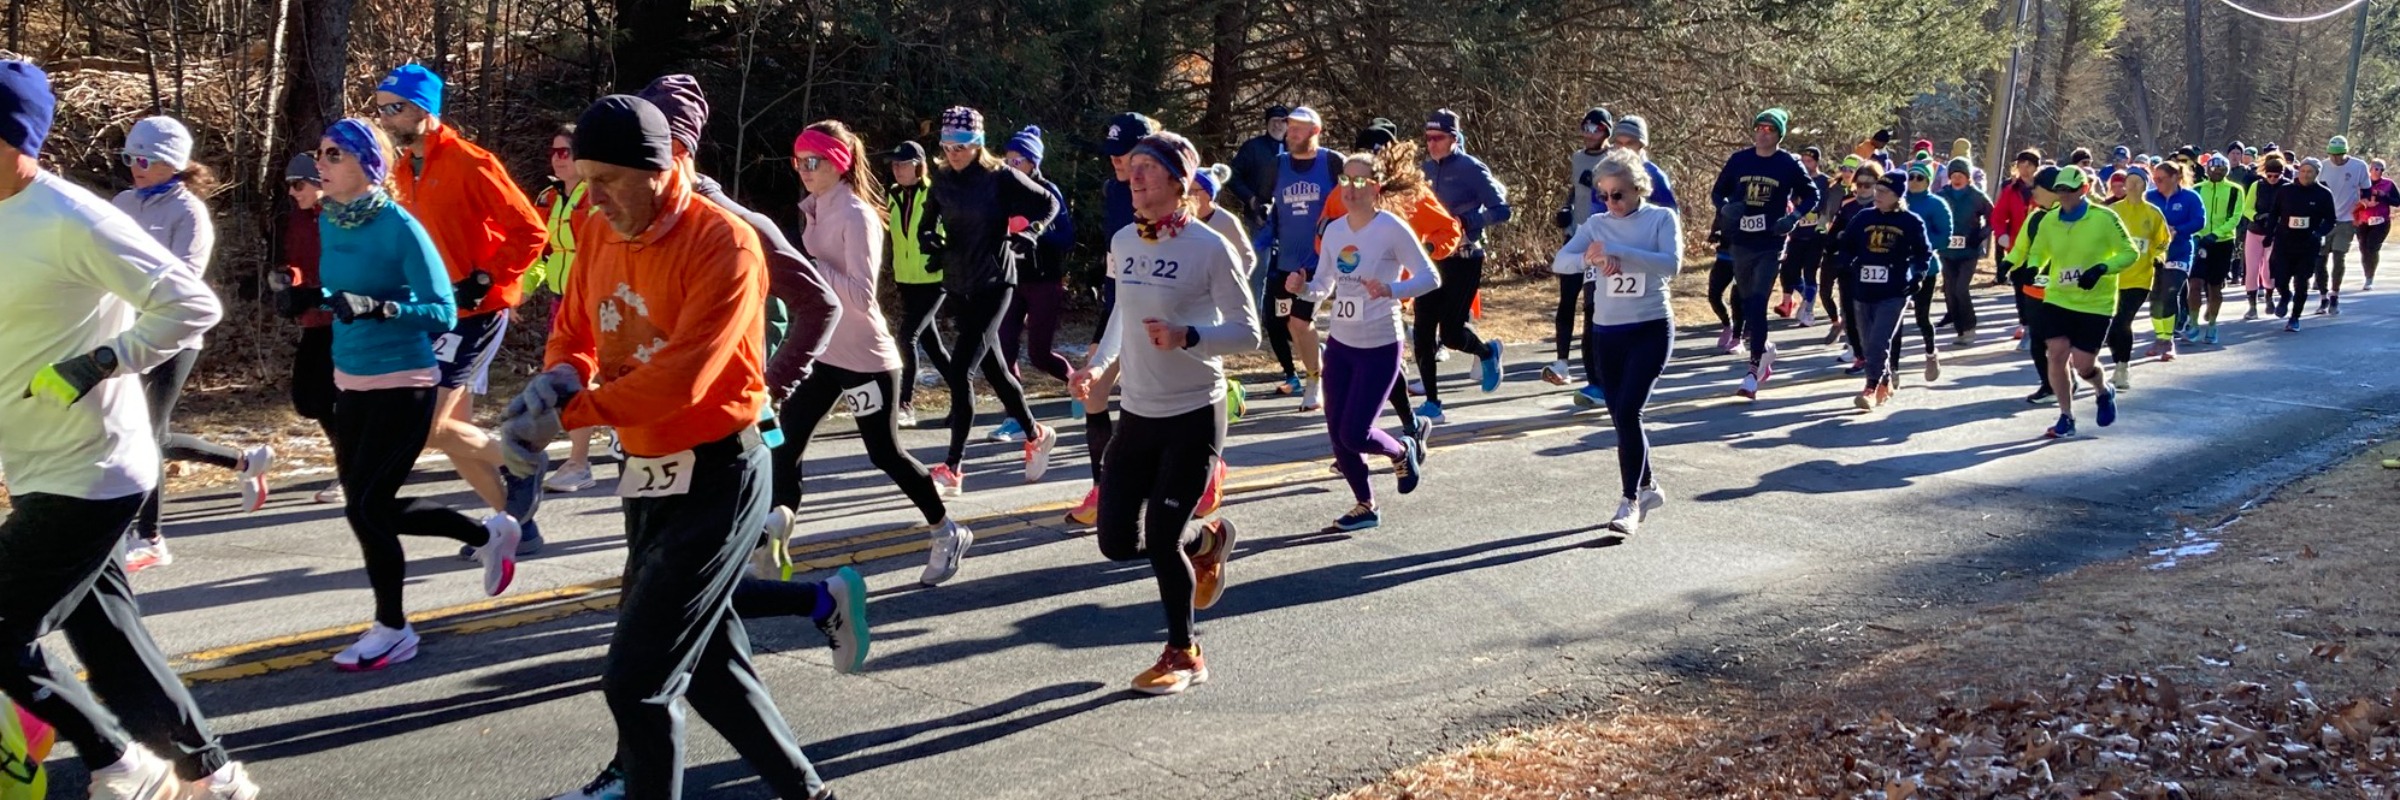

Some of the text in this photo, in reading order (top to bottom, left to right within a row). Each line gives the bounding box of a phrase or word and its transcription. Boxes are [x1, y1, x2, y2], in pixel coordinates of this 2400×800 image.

[1742, 217, 1764, 229] 308
[1862, 268, 1887, 280] 312
[1613, 277, 1637, 294] 22
[1337, 301, 1356, 318] 20
[847, 391, 876, 412] 92
